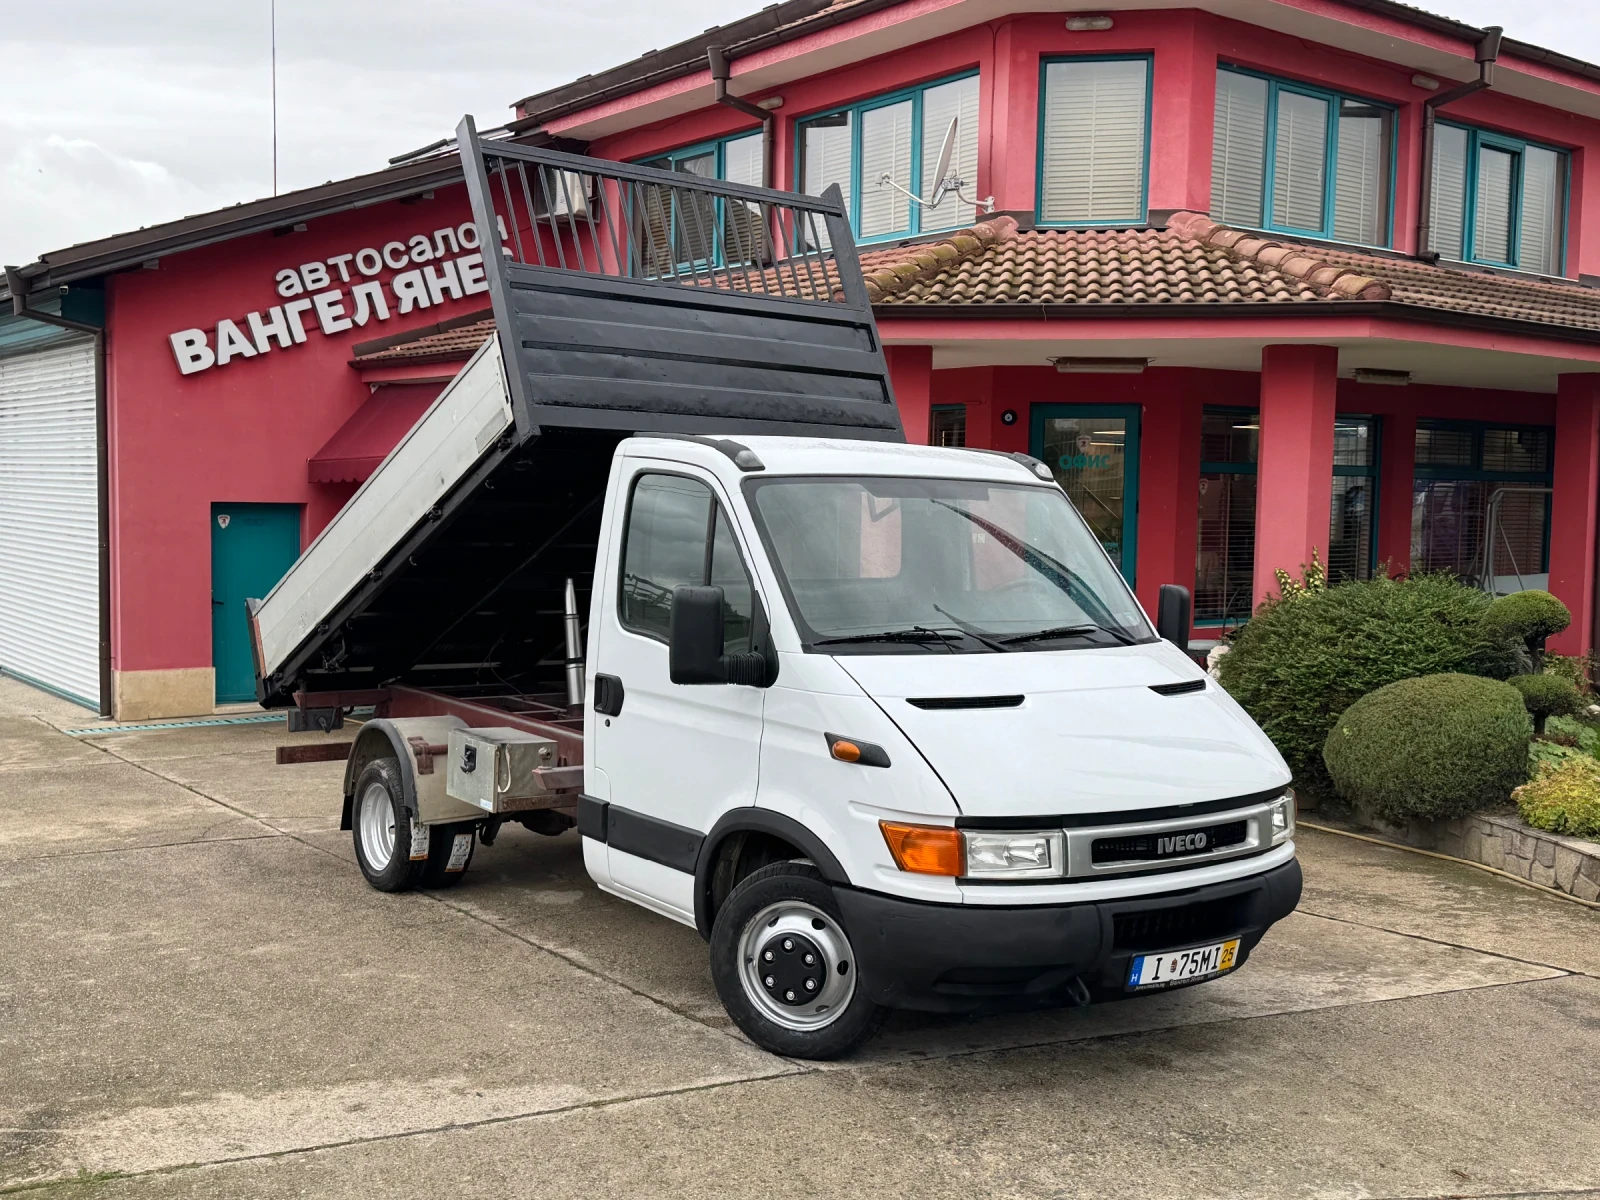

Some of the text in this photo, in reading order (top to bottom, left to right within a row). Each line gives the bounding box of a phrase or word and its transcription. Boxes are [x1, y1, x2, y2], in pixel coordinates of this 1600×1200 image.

[168, 246, 513, 375] ВАНГЕЛ ЯНЕ
[1059, 455, 1110, 469] ОФИС
[1157, 833, 1207, 854] IVECO
[1221, 947, 1235, 964] 25
